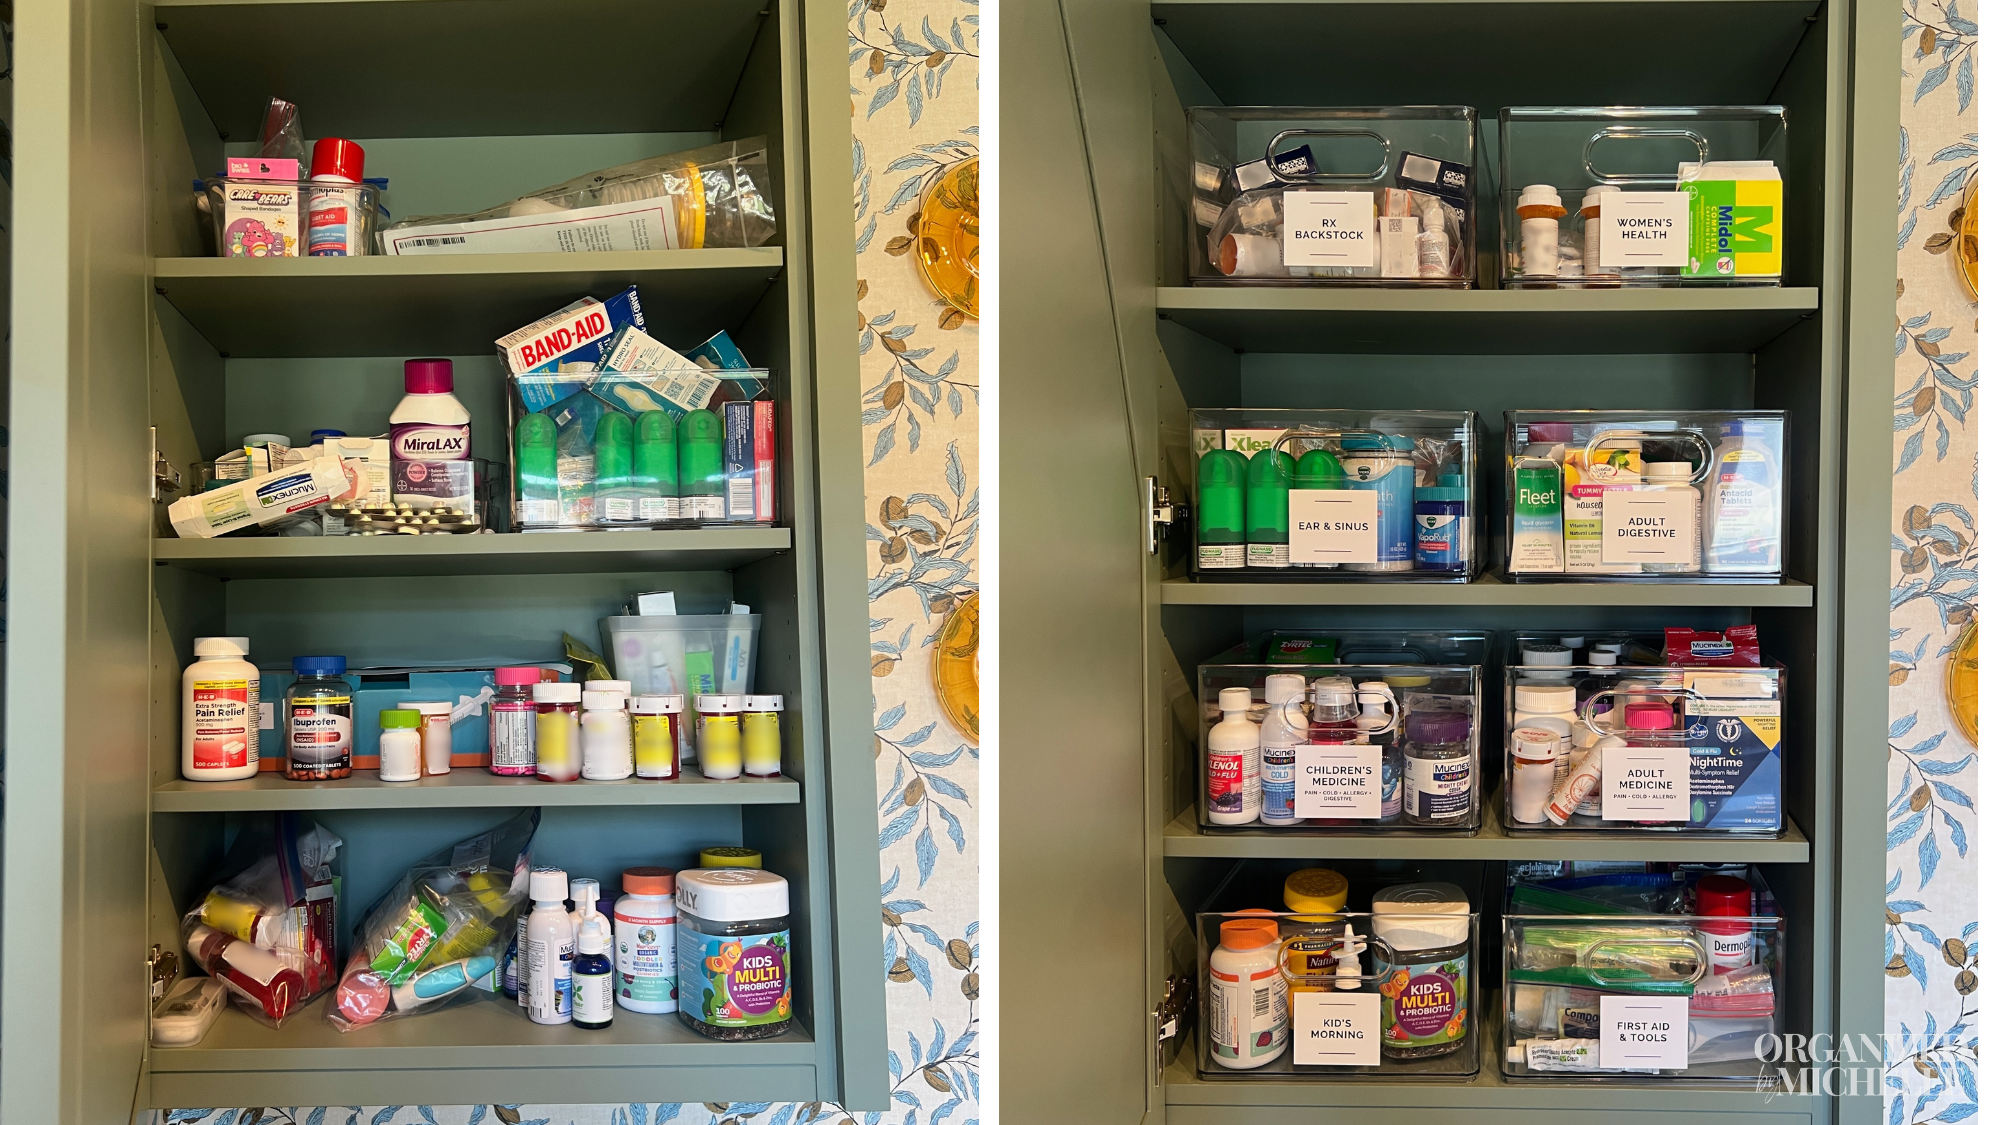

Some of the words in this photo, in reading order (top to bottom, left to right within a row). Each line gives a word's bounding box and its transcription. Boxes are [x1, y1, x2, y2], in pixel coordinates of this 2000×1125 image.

[229, 189, 258, 200] CARE
[257, 194, 291, 206] BEARS
[1322, 219, 1336, 227] RX
[1617, 218, 1672, 227] WOMEN'S
[1719, 206, 1732, 252] Midol
[1735, 206, 1773, 253] M
[1296, 231, 1363, 239] BACKSTOCK
[1622, 231, 1667, 239] HEALTH
[628, 290, 645, 326] BAND-AID
[521, 312, 605, 368] BAND-AID
[613, 346, 626, 366] HYDRO
[624, 334, 635, 348] SEAL
[404, 438, 462, 450] MiraLAX
[274, 482, 316, 501] Mucinex
[1520, 489, 1556, 504] Fleet
[1298, 522, 1320, 530] EAR
[1324, 522, 1331, 531] &
[1335, 522, 1369, 531] SINUS
[1418, 534, 1450, 542] VapoRub
[1618, 529, 1675, 537] DIGESTIVE
[218, 708, 244, 716] Relief
[294, 718, 336, 727] Ibuprofen
[1435, 762, 1470, 772] Mucinex
[1690, 757, 1743, 769] NightTime
[1306, 766, 1372, 774] CHILDREN'S
[1441, 771, 1467, 780] Children's
[1620, 781, 1672, 789] MEDICINE
[743, 956, 772, 968] KIDS
[736, 968, 779, 984] MULTI
[740, 980, 781, 992] PROBIOTIC
[1411, 983, 1442, 995] KIDS
[1402, 992, 1449, 1008] MULTI
[1406, 1005, 1451, 1016] PROBIOTIC
[1323, 1019, 1351, 1027] KID'S
[1617, 1022, 1647, 1030] FIRST
[1651, 1022, 1669, 1030] AID
[1311, 1030, 1364, 1039] MORNING
[1620, 1033, 1626, 1041] &
[1631, 1033, 1667, 1042] TOOLS
